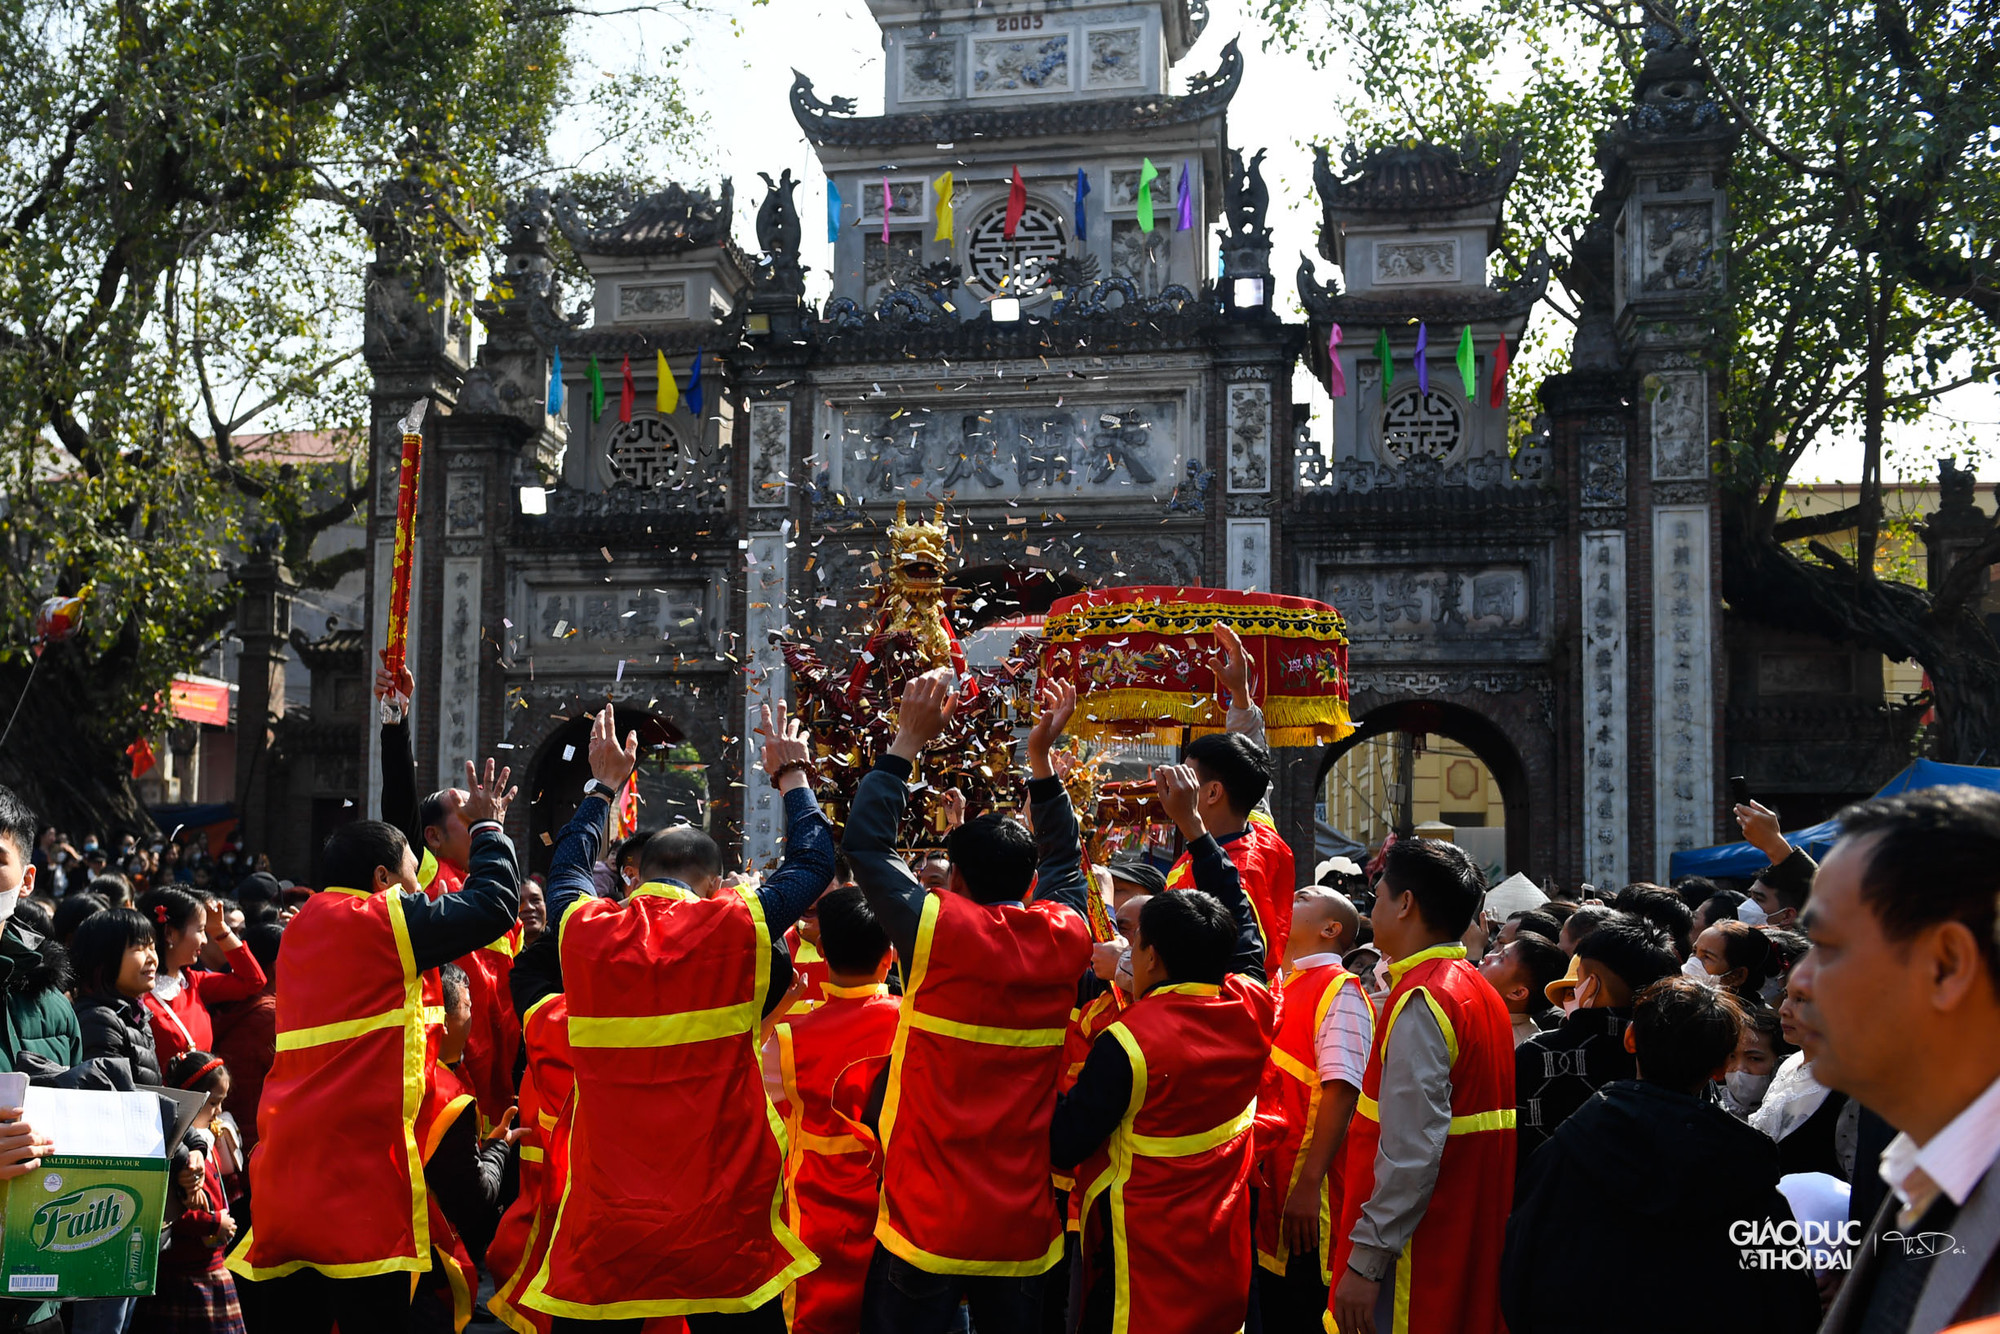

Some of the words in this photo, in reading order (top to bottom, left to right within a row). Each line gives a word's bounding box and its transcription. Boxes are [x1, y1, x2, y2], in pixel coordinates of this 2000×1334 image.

[45, 1157, 74, 1165] SALTED
[76, 1158, 104, 1166] LEMON
[105, 1159, 140, 1167] FLAVOUR
[33, 1192, 124, 1251] Faith
